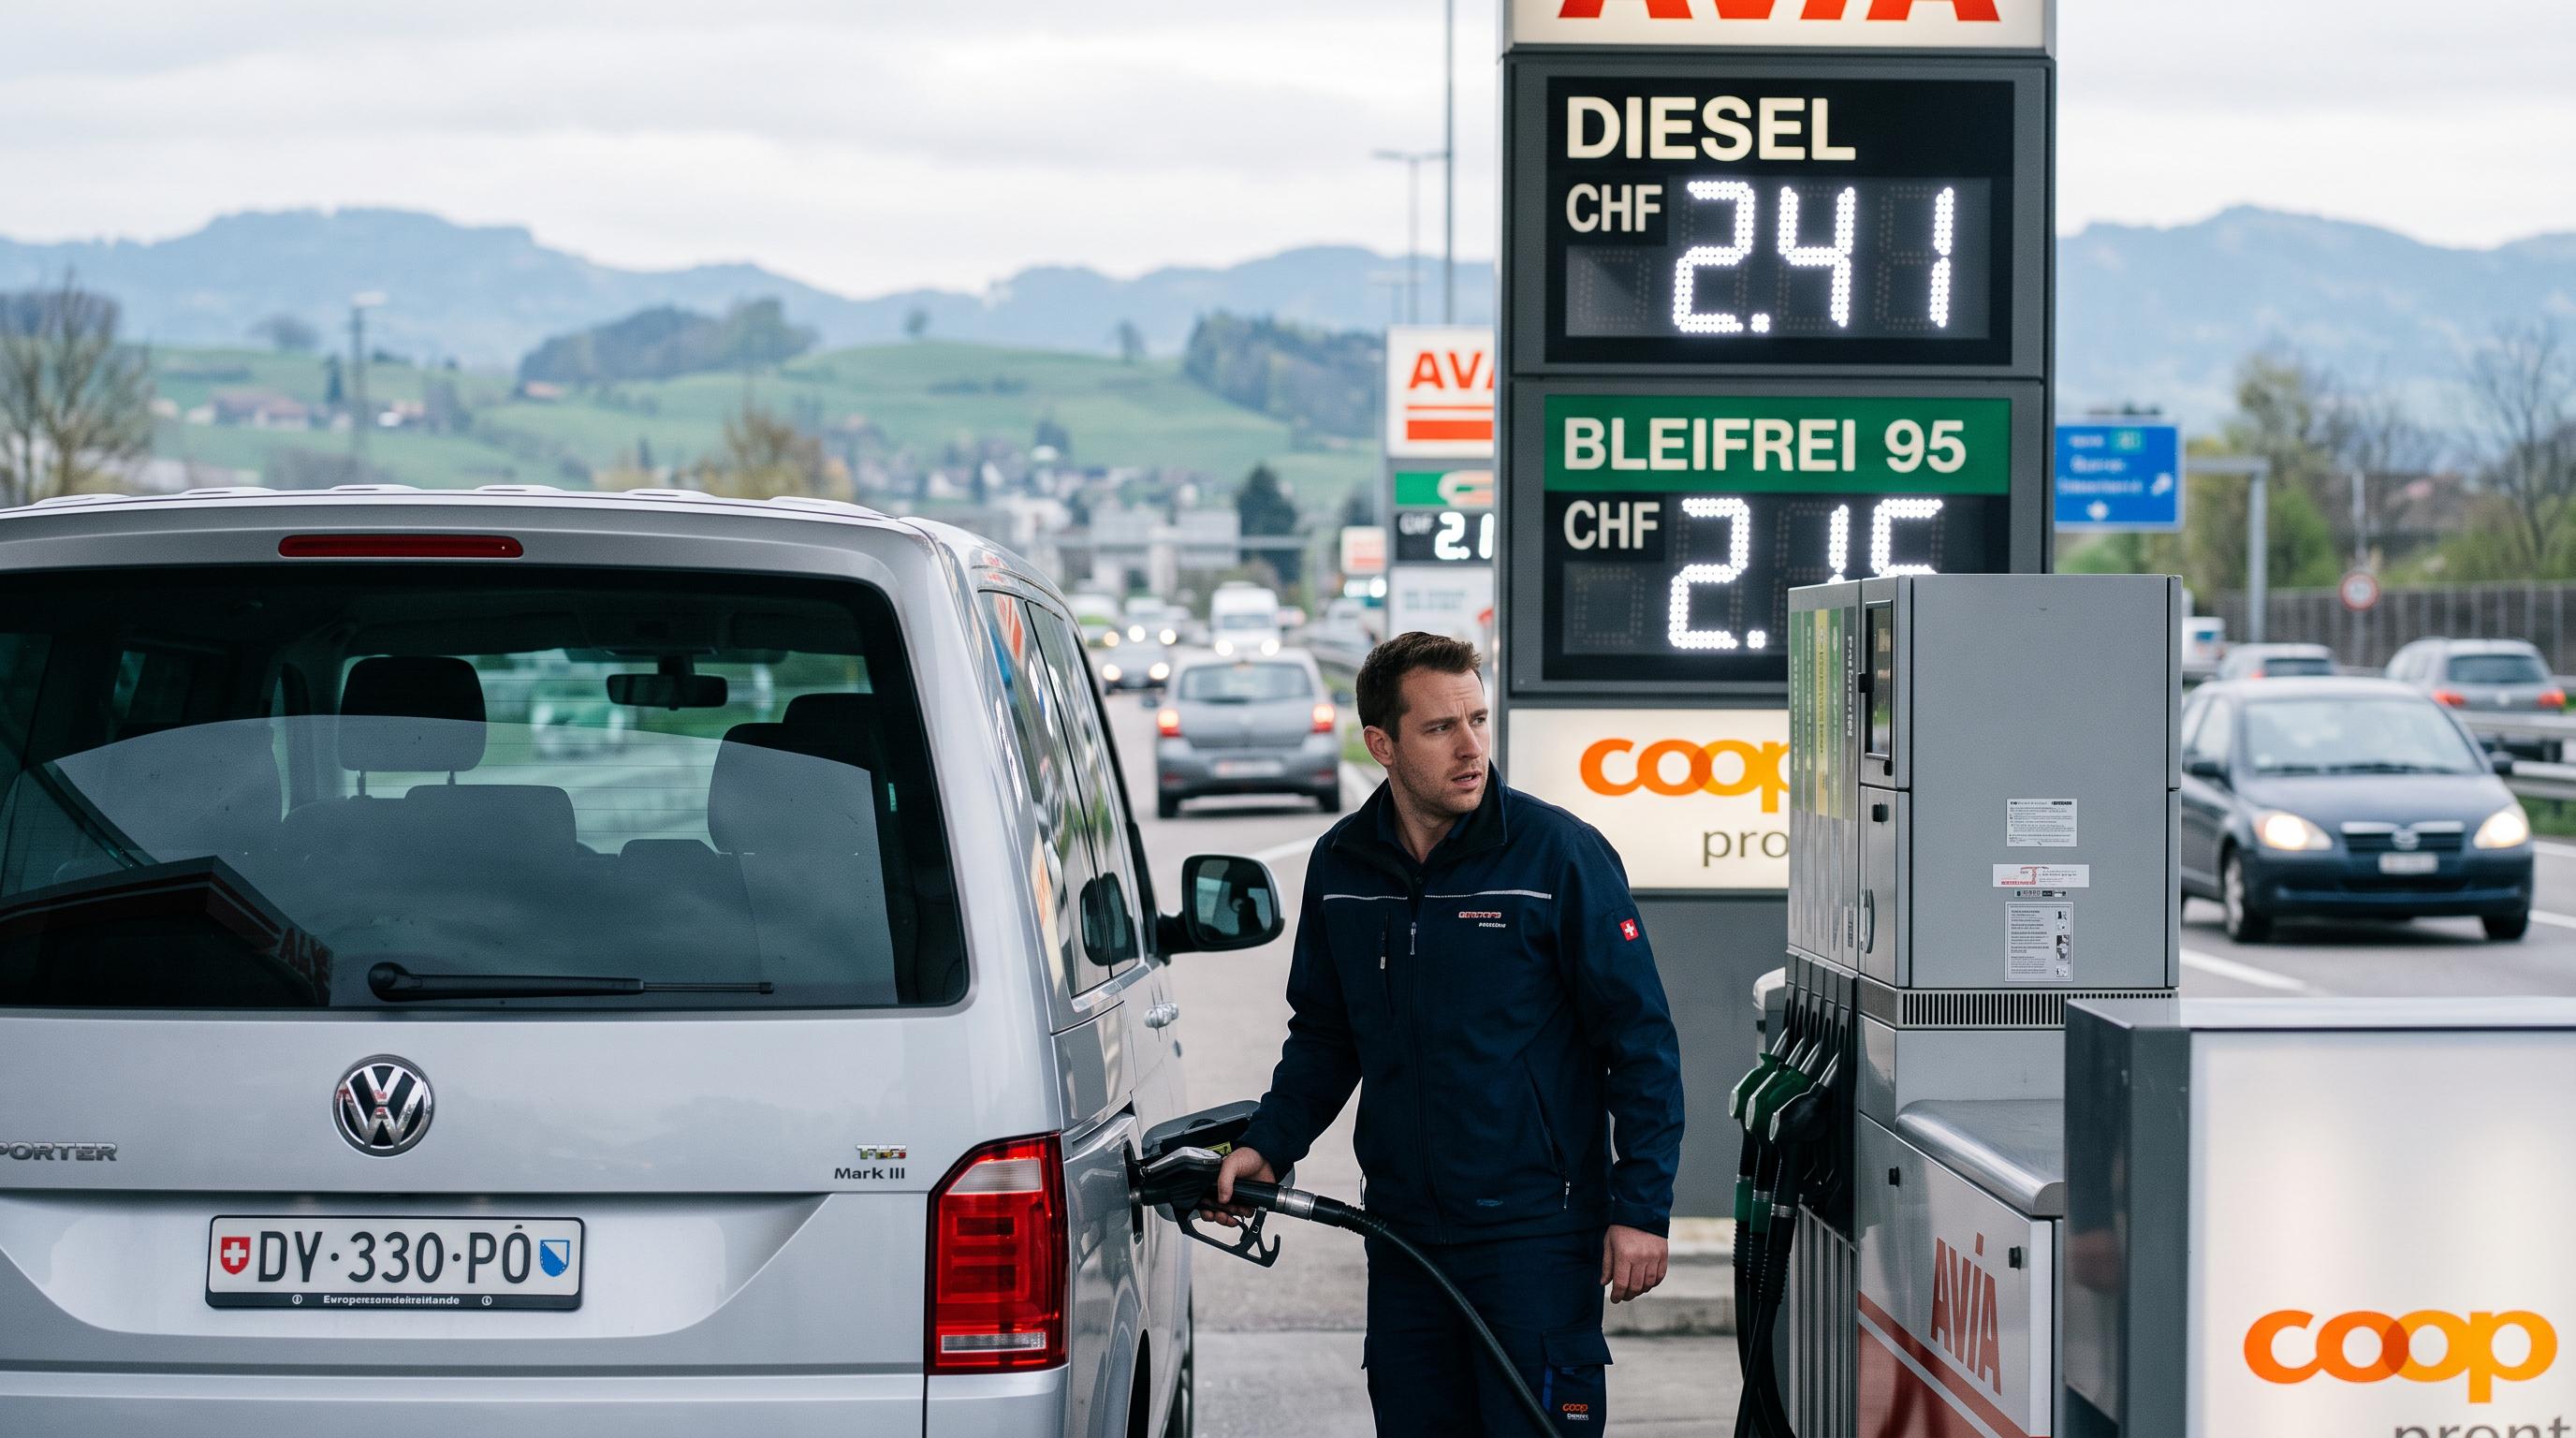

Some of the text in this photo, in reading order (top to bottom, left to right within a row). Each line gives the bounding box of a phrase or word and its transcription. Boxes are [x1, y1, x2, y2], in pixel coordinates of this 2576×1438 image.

[1567, 95, 1856, 161] DIESEL
[1566, 179, 1956, 333] CHF 2.41
[1408, 350, 1495, 390] AV
[1564, 418, 1966, 474] BLEIFREI 95
[1564, 500, 1660, 550] CHF
[834, 1167, 905, 1180] Mark III
[2244, 1309, 2558, 1404] coop
